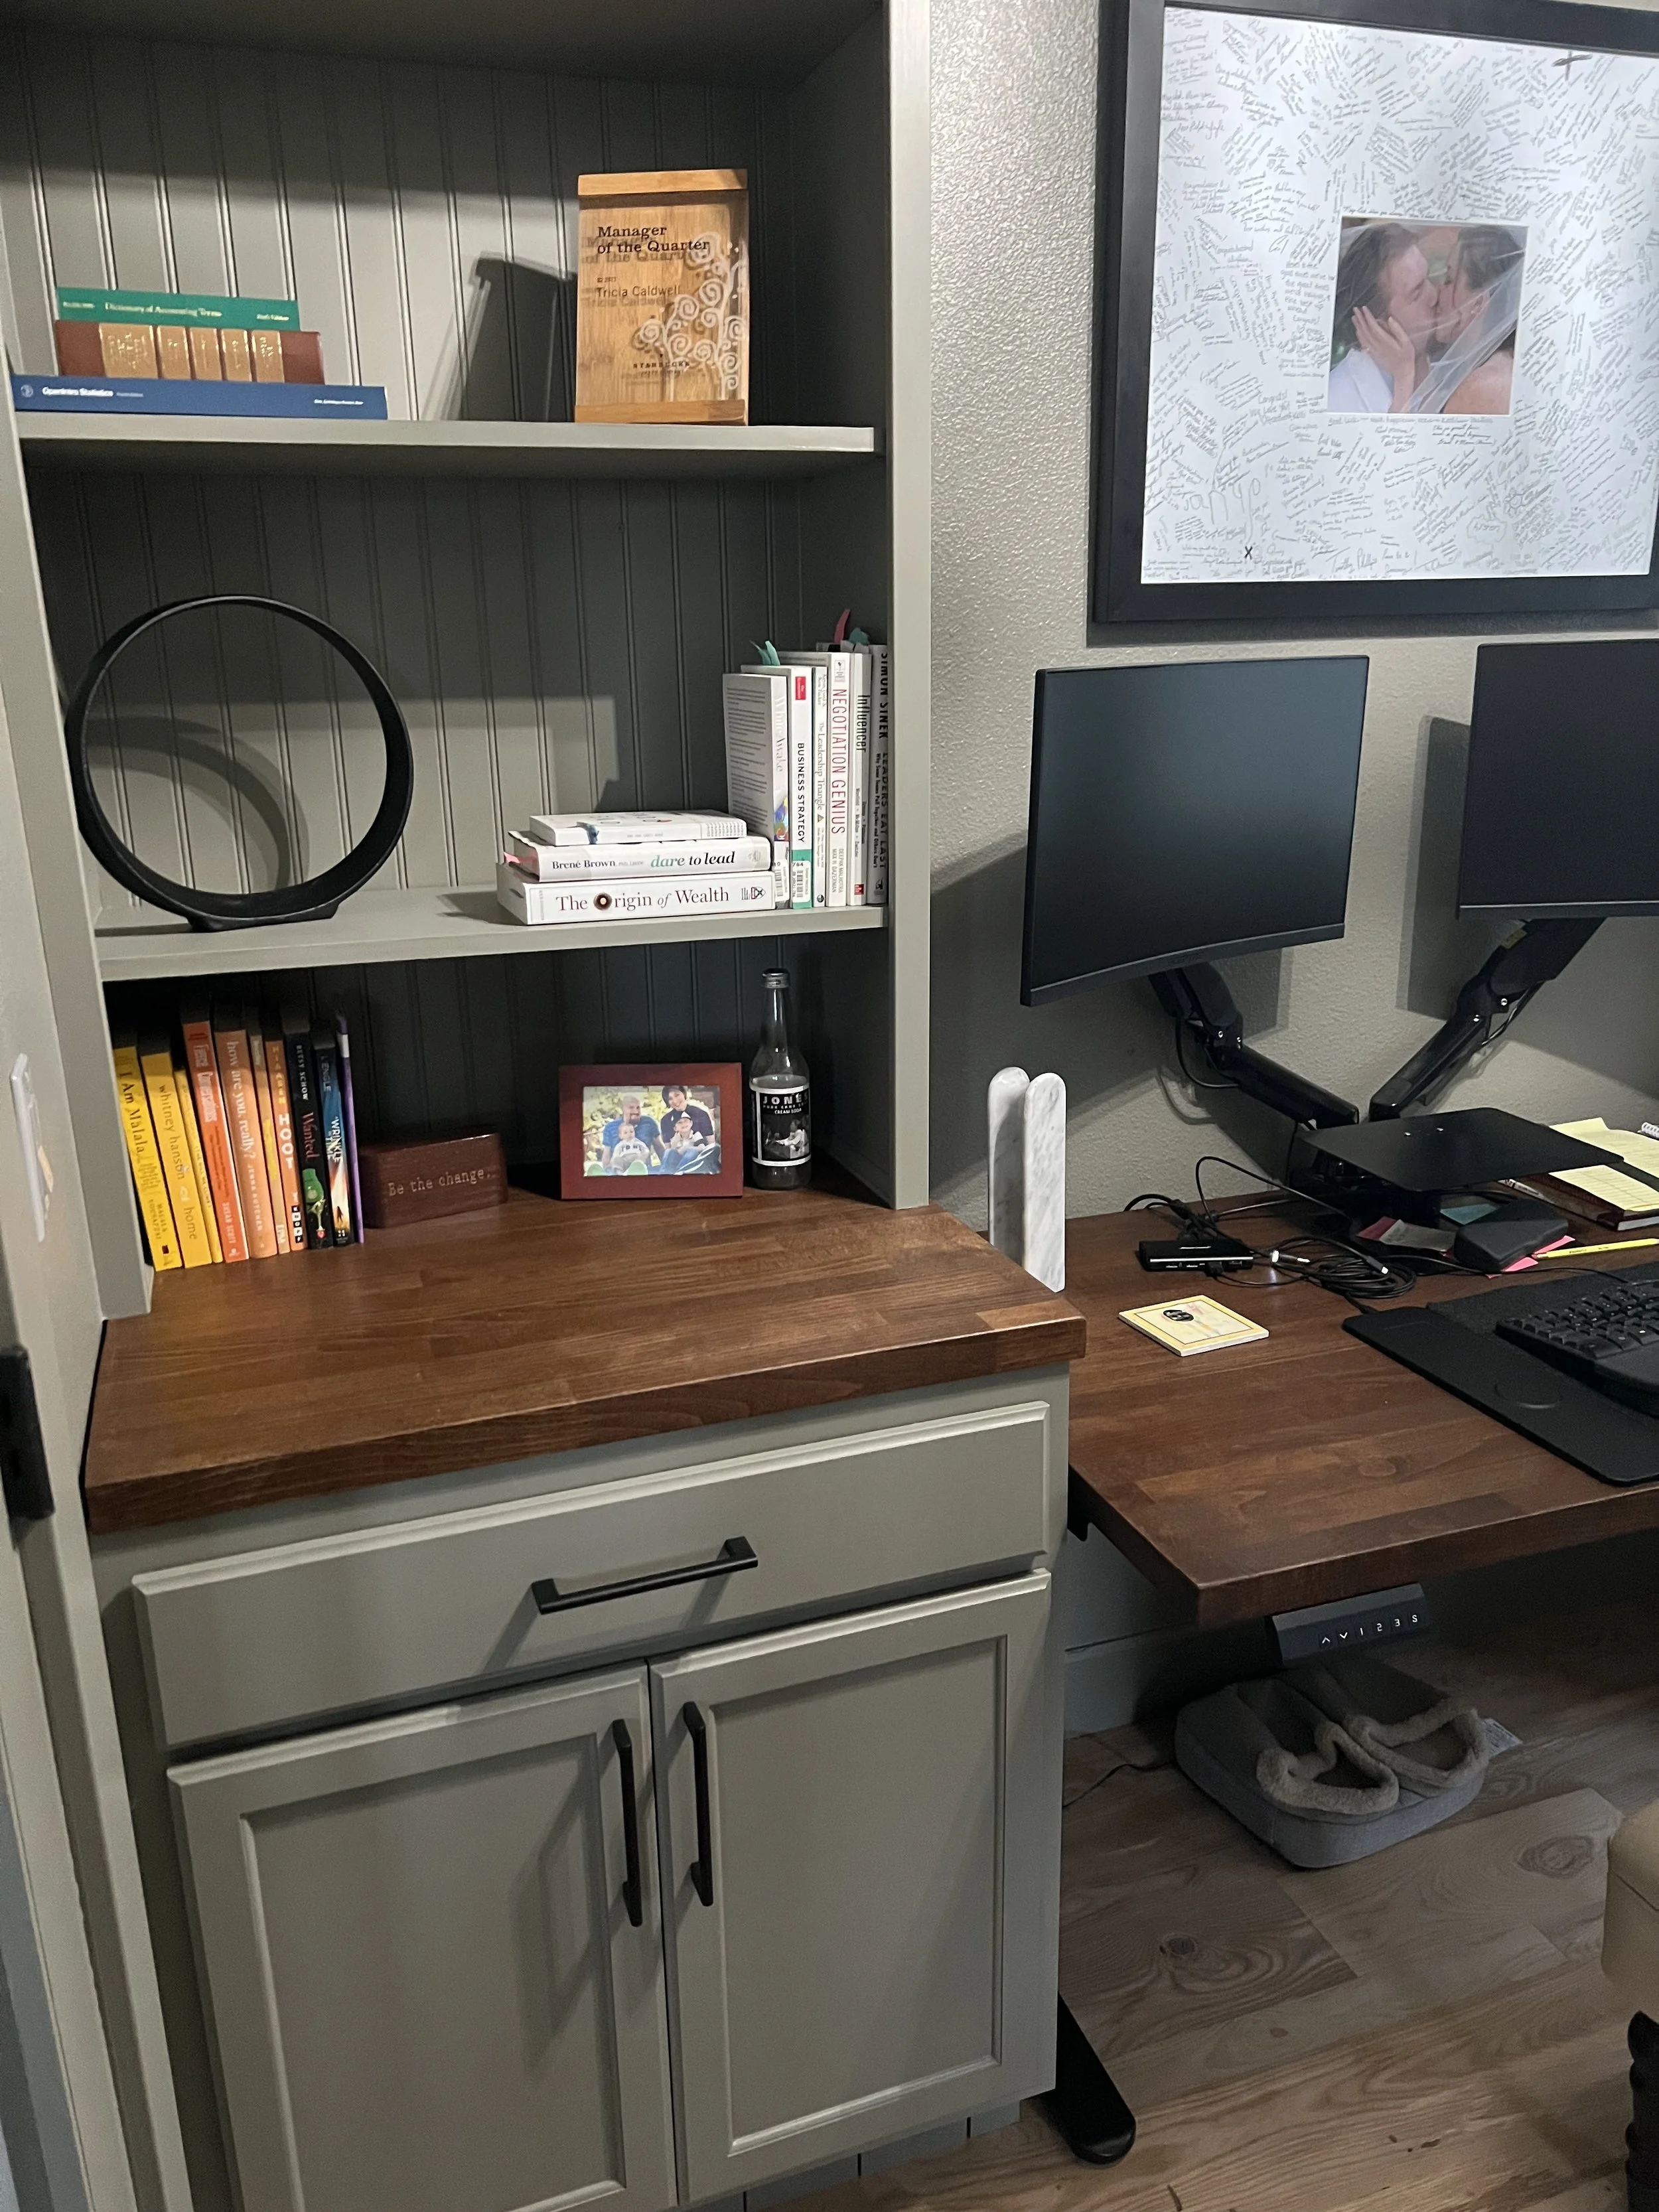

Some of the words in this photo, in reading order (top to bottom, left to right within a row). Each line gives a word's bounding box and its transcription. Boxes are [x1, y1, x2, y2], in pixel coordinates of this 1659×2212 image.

[597, 225, 668, 238] Manager
[597, 242, 614, 254] of
[616, 242, 642, 253] the
[647, 240, 710, 252] Quarter
[597, 287, 628, 298] Tricia
[632, 285, 680, 297] Caldwell
[632, 360, 690, 369] STARBUCKS
[831, 689, 847, 774] NEGOTIATION
[856, 695, 871, 753] Influencer
[879, 702, 888, 739] SINEK
[814, 733, 826, 777] Leadership
[815, 779, 825, 810] Triangle
[831, 780, 846, 834] GENIUS
[551, 859, 582, 871] Brené
[583, 857, 616, 868] Brown
[650, 854, 686, 868] dare
[689, 855, 701, 866] to
[703, 850, 736, 865] lead
[555, 894, 589, 912] The
[593, 891, 652, 913] Origin
[657, 891, 672, 909] of
[674, 886, 730, 905] Wealth
[226, 1041, 239, 1067] how
[121, 1082, 135, 1104] Am
[230, 1070, 243, 1089] are
[299, 1070, 309, 1101] SCHOW
[762, 1092, 808, 1105] JONES
[127, 1107, 149, 1155] Malala
[159, 1084, 175, 1133] whitney
[169, 1132, 185, 1180] hanson
[236, 1119, 256, 1159] really?
[278, 1113, 295, 1170] HOOT
[301, 1111, 320, 1162] Wanted
[330, 1119, 342, 1163] WRINKLE
[388, 1182, 404, 1197] Be
[409, 1176, 433, 1193] the
[182, 1206, 198, 1240] home
[1376, 1623, 1383, 1632] 2
[1394, 1618, 1401, 1627] 3
[1411, 1614, 1418, 1623] S
